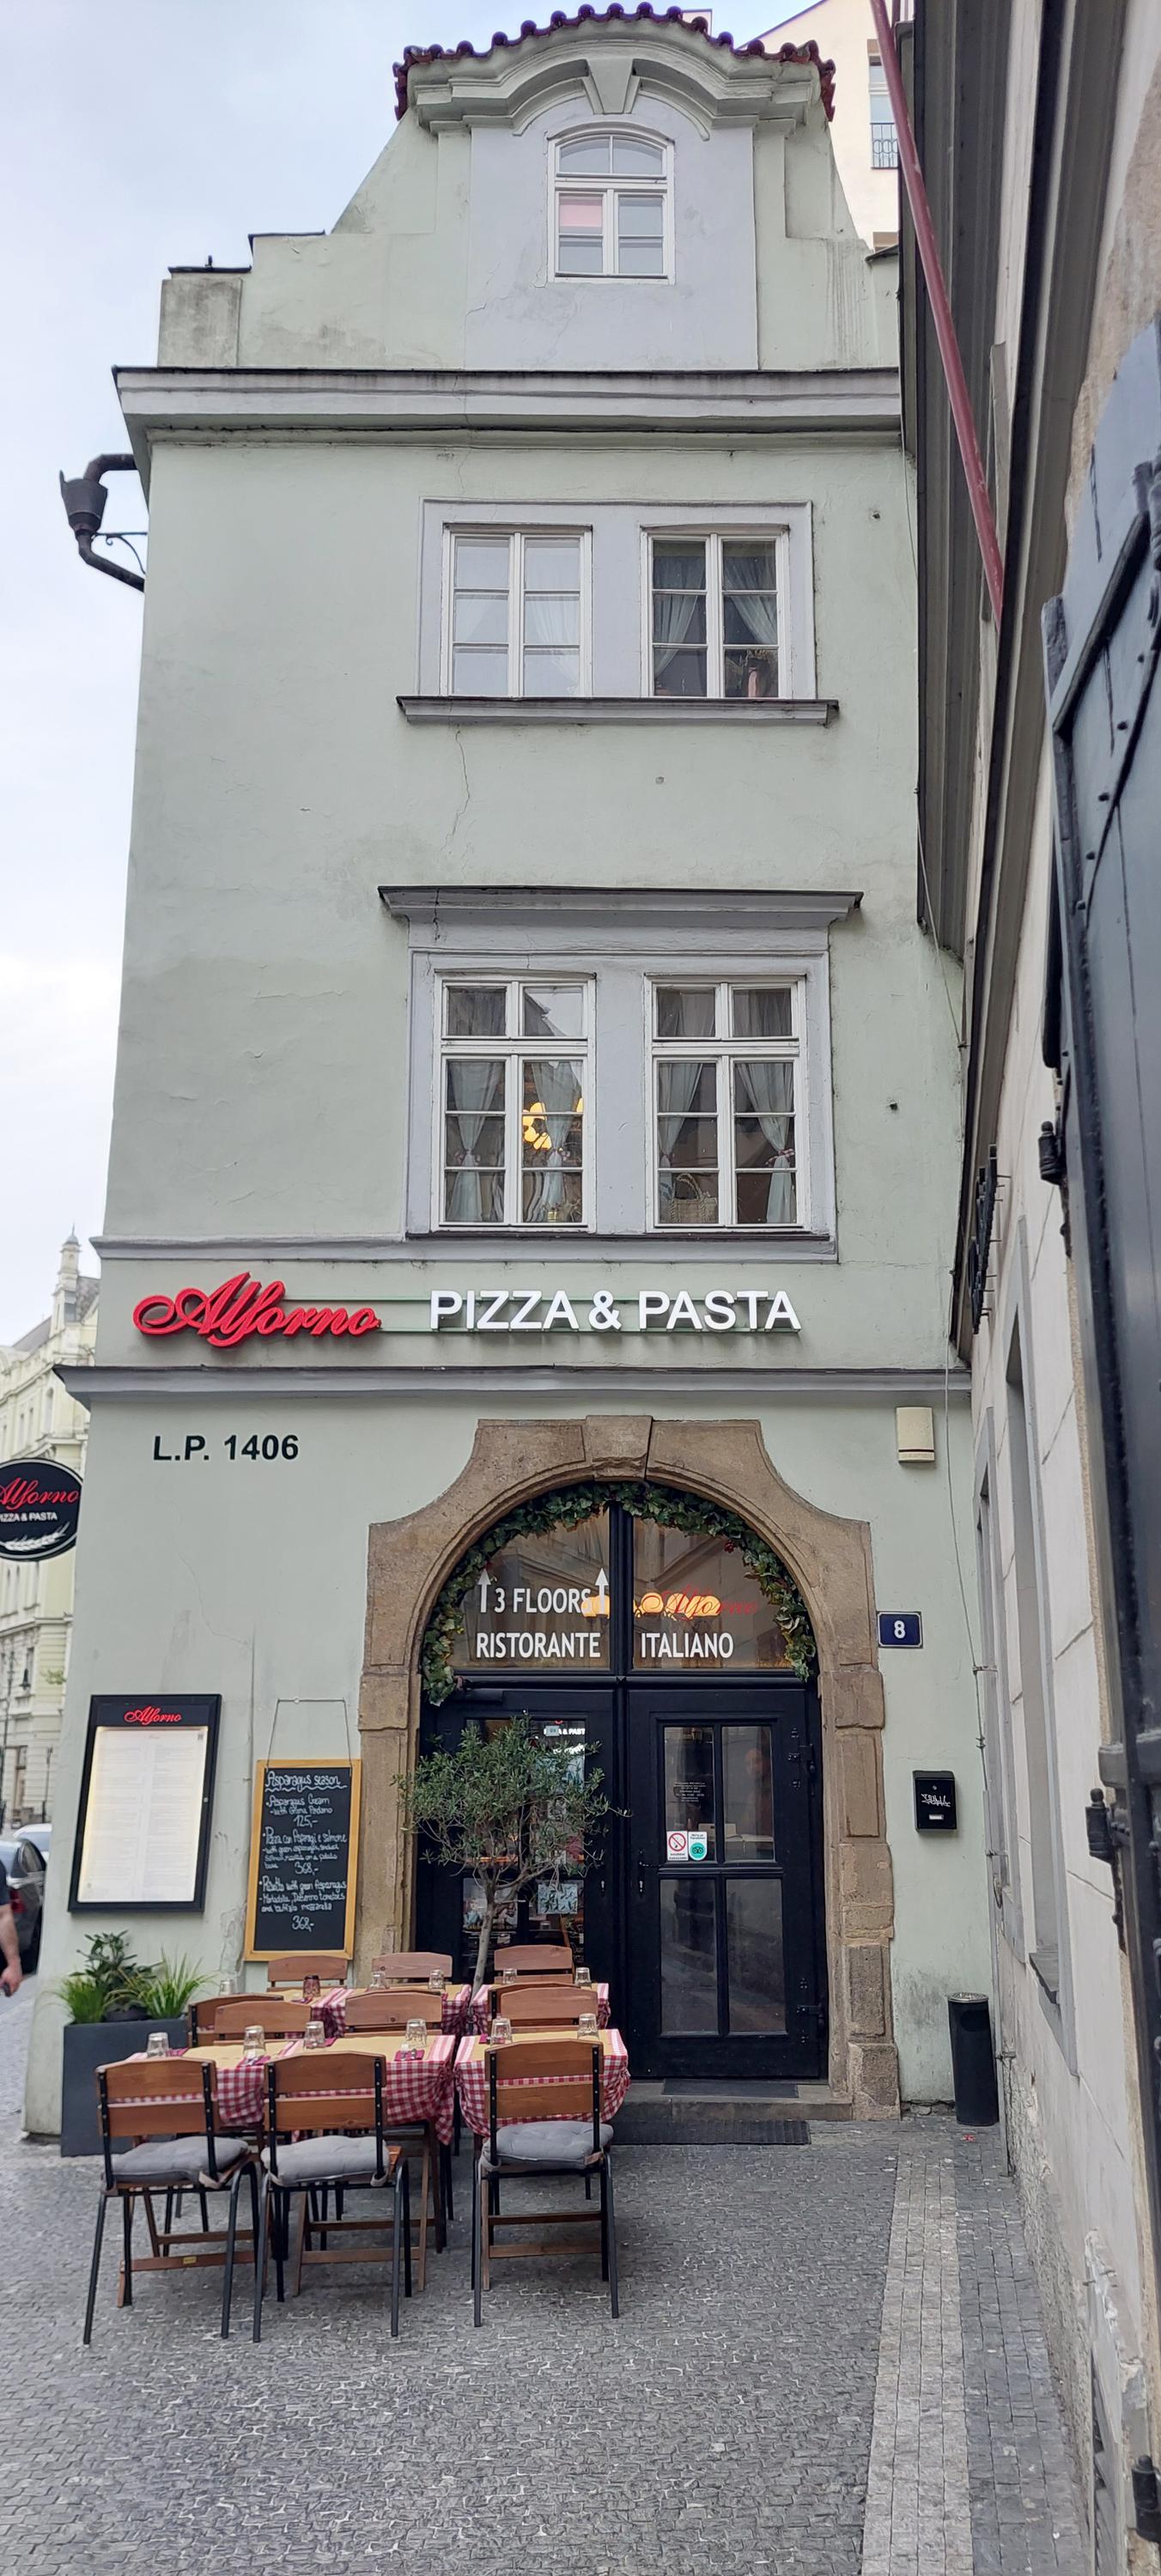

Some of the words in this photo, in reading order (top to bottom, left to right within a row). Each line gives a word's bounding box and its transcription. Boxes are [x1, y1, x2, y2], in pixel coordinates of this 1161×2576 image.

[133, 1272, 381, 1347] Alforno
[430, 1290, 580, 1331] PIZZA
[588, 1290, 622, 1331] &
[639, 1291, 801, 1332] PASTA
[153, 1435, 210, 1461] L.P.
[223, 1435, 299, 1461] 1406
[0, 1513, 20, 1522] IZZA
[21, 1513, 27, 1522] &
[29, 1512, 58, 1522] PASTA
[495, 1588, 505, 1613] 3
[513, 1588, 591, 1613] FLOORS
[894, 1619, 906, 1639] 8
[477, 1632, 600, 1658] RISTORANTE
[641, 1632, 733, 1658] ITALIANO
[124, 1705, 182, 1726] Alforno
[265, 1771, 312, 1792] Asparagus
[313, 1775, 341, 1785] season
[269, 1795, 305, 1807] Asparagus
